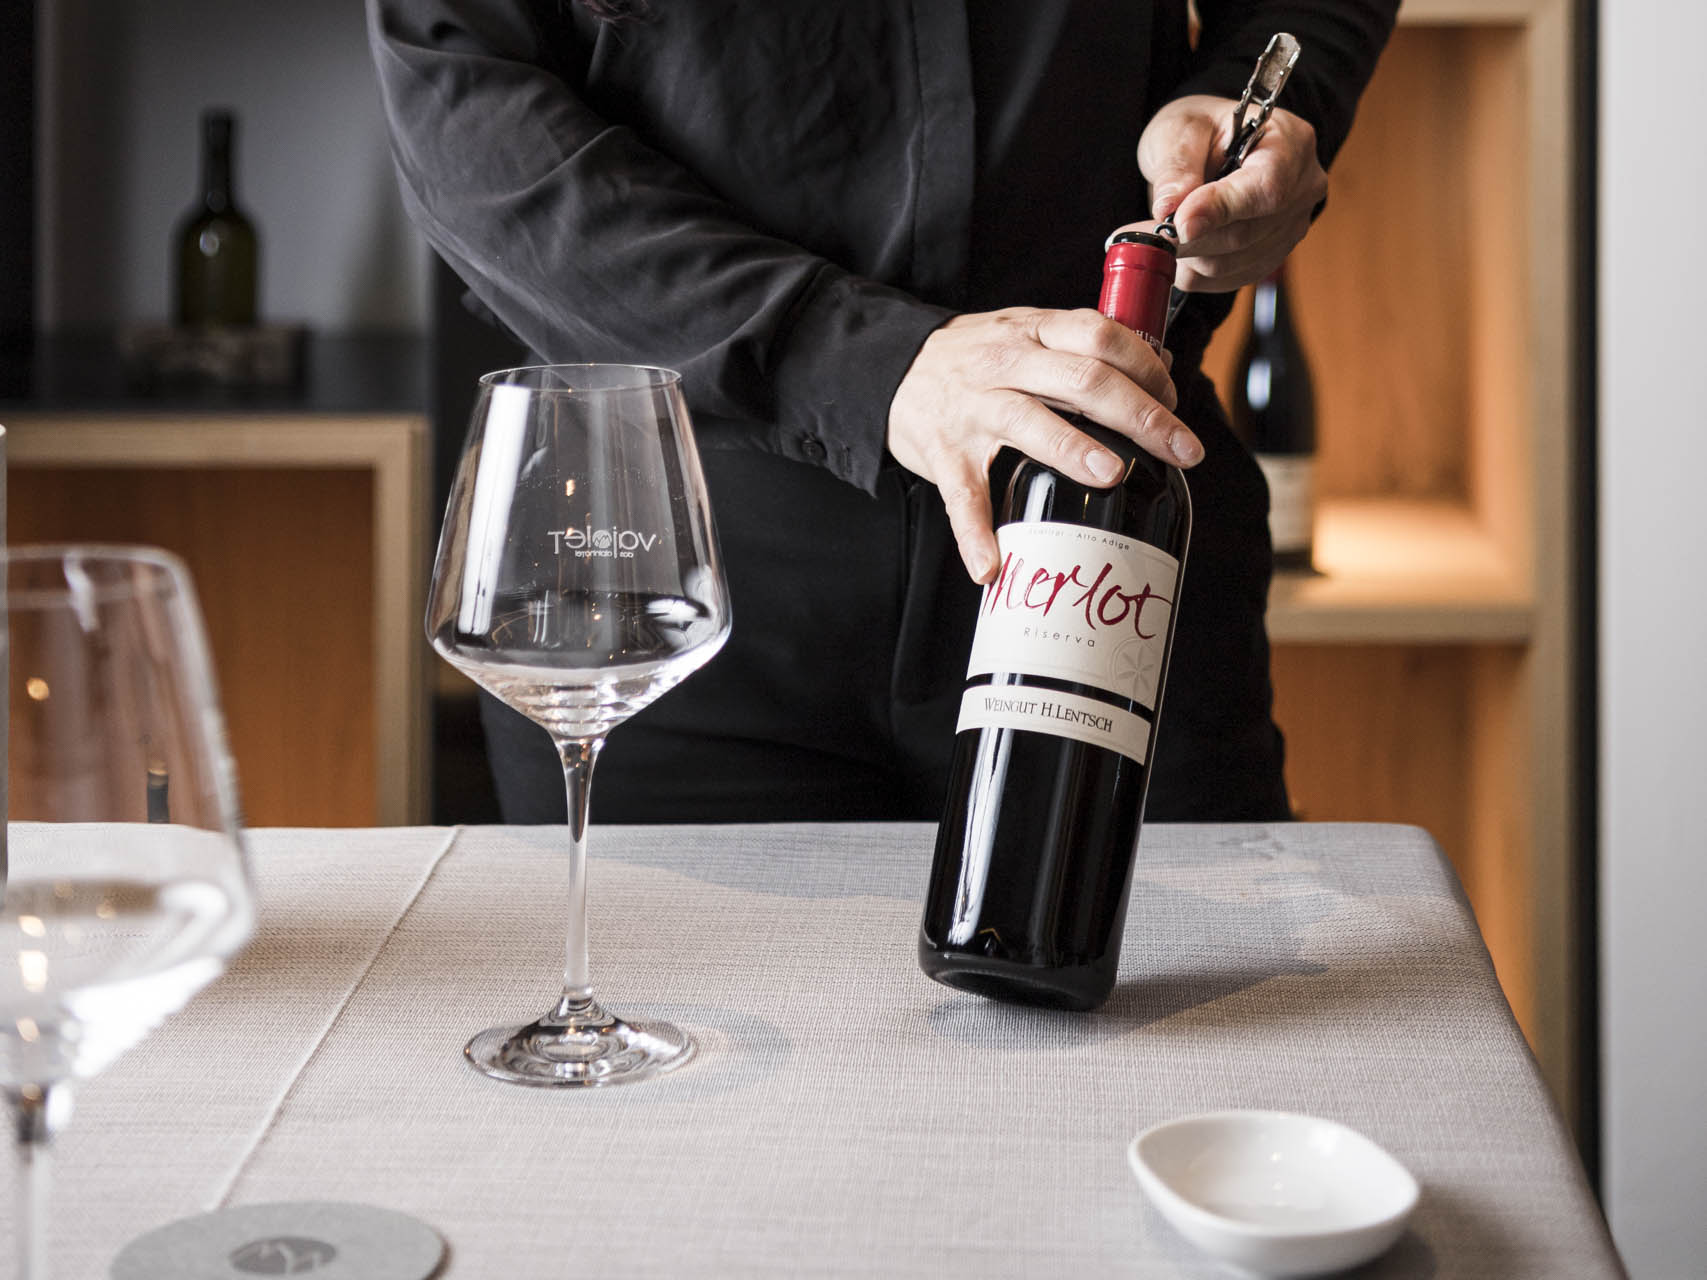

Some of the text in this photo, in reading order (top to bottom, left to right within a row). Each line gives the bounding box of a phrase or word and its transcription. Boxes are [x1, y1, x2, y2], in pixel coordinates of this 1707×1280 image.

[1102, 537, 1130, 551] Adige
[981, 551, 1173, 640] Merlot
[1023, 626, 1096, 648] Riserva
[984, 697, 1038, 714] WEINGUT
